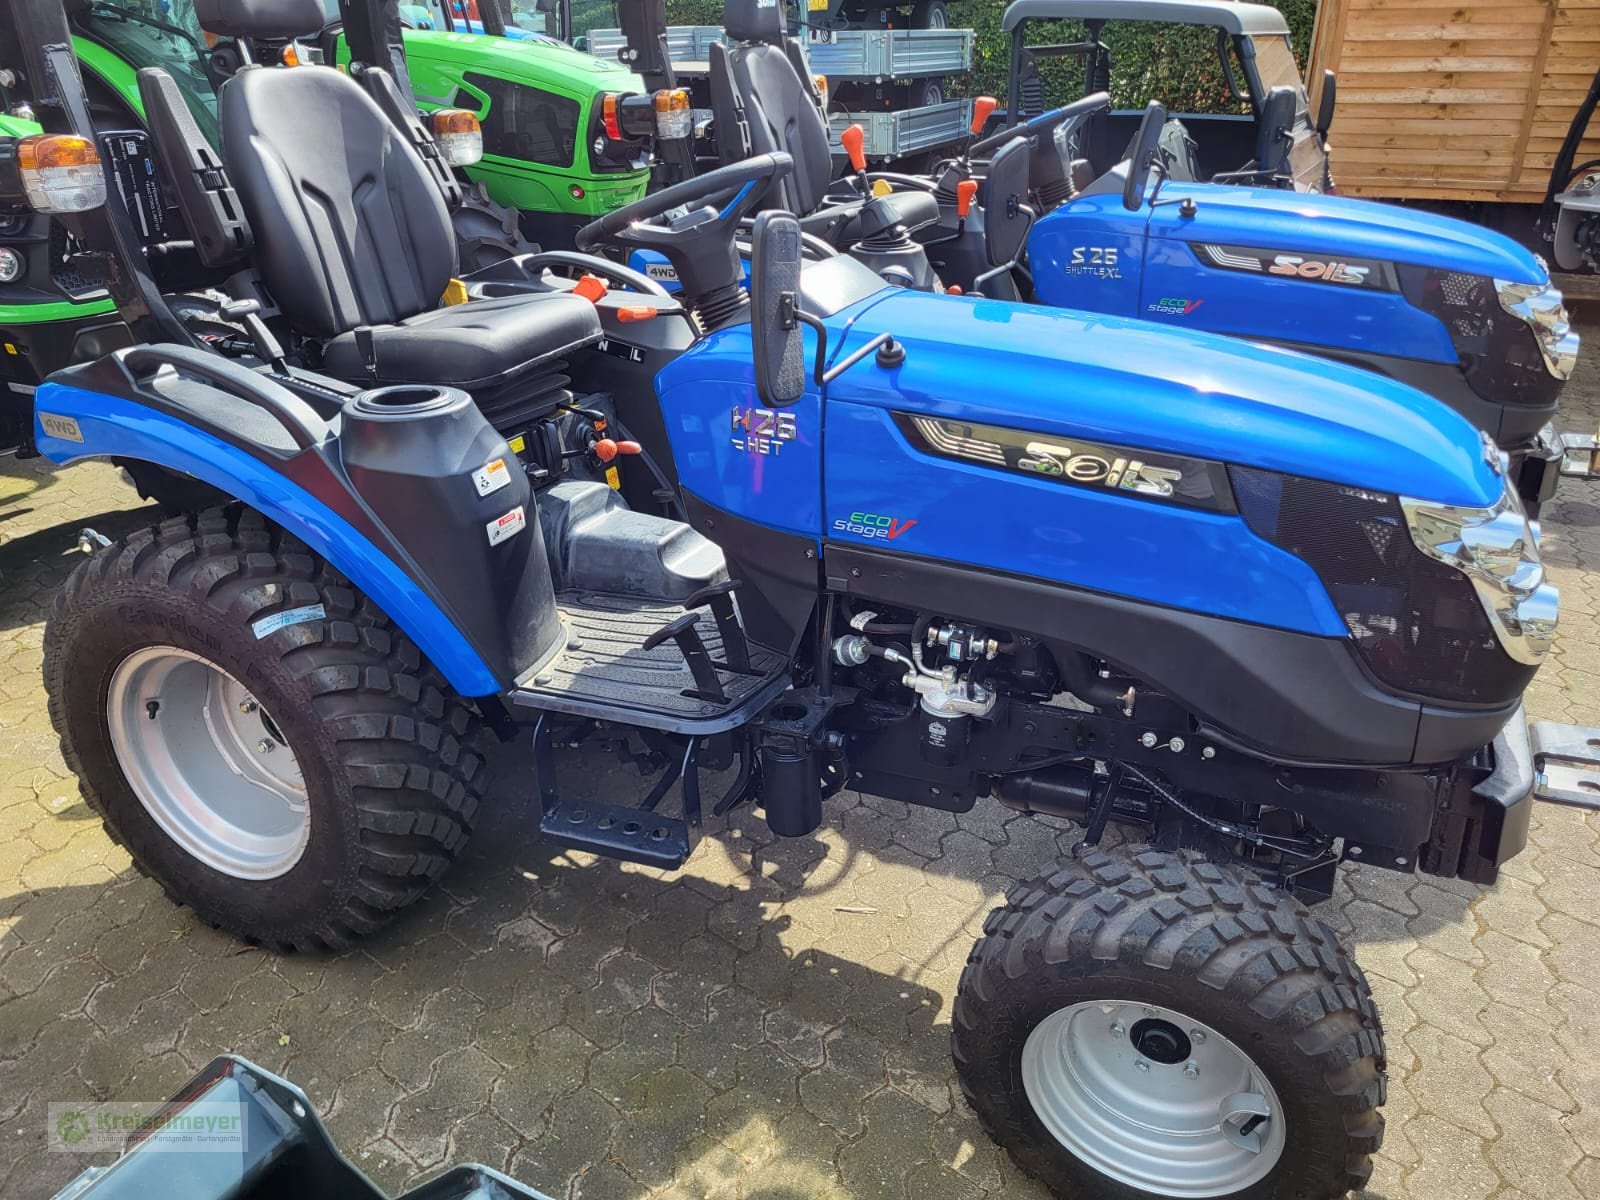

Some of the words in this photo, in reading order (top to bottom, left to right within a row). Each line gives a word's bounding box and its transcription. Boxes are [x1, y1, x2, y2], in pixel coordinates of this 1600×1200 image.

[1071, 247, 1086, 264] S
[1089, 247, 1118, 265] 26
[649, 267, 676, 278] 4WD
[1160, 297, 1188, 307] ECO
[45, 418, 77, 436] 4WD
[731, 405, 797, 440] H26
[747, 436, 784, 456] HST
[850, 511, 892, 527] ECO
